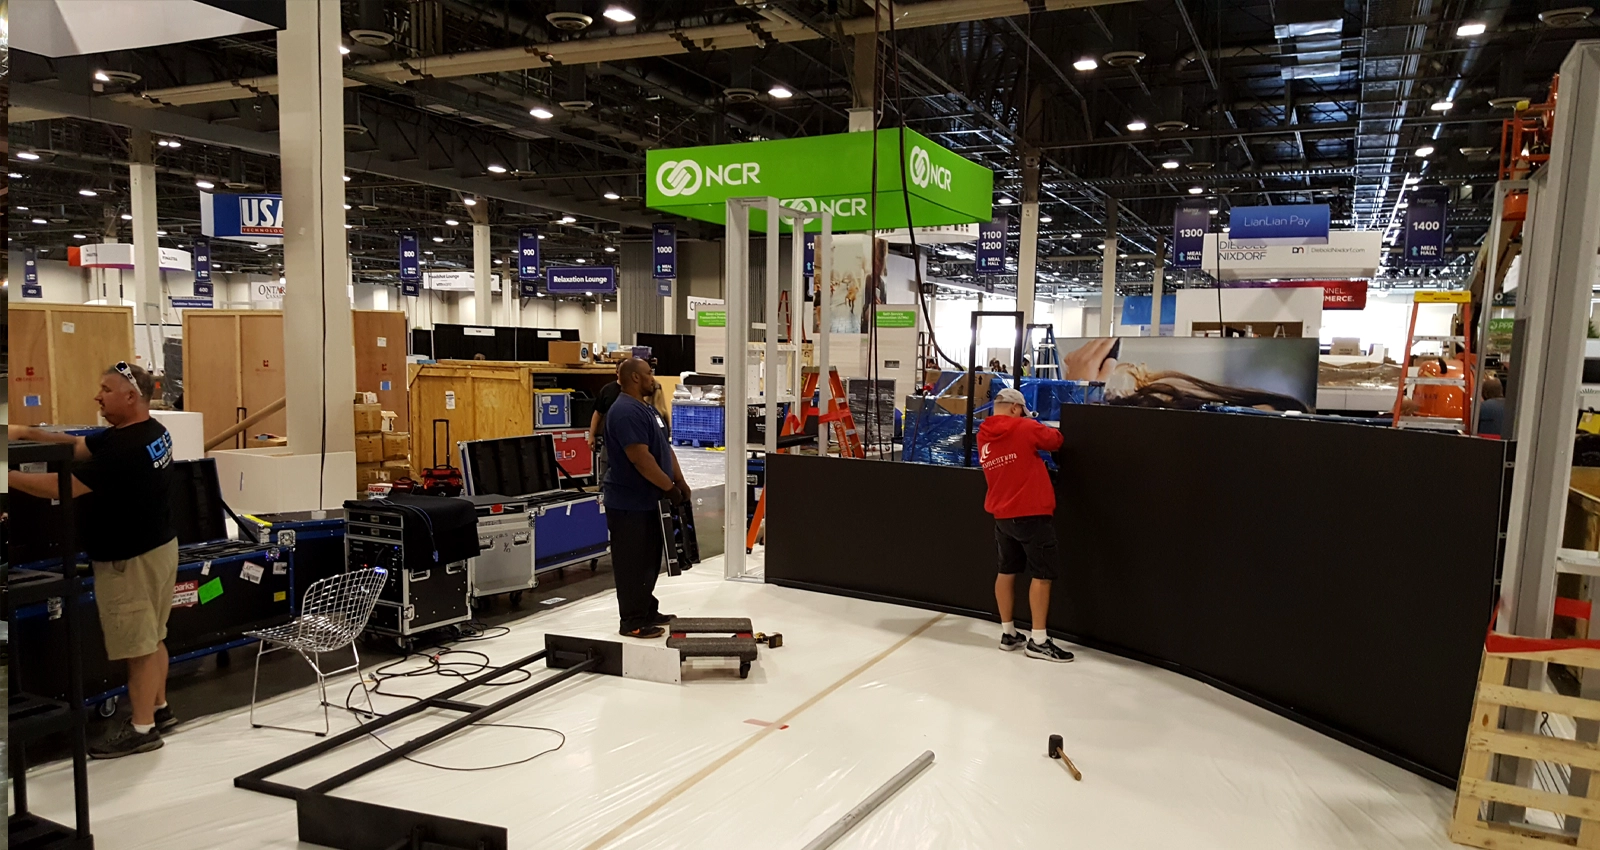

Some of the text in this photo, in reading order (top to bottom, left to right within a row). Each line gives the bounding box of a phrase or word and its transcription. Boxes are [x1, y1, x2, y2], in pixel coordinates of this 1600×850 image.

[706, 162, 761, 187] NCR
[931, 164, 952, 192] NCR
[820, 198, 867, 216] NCR
[1244, 215, 1311, 228] LianLian Pay
[1413, 221, 1440, 231] 1400
[982, 231, 1002, 239] 1100
[1179, 228, 1203, 238] 1300
[981, 241, 1002, 250] 1200
[523, 248, 535, 256] 900
[1219, 252, 1267, 261] NIXDORF
[553, 275, 608, 284] Relaxation Lounge
[1322, 287, 1347, 295] NNEL.
